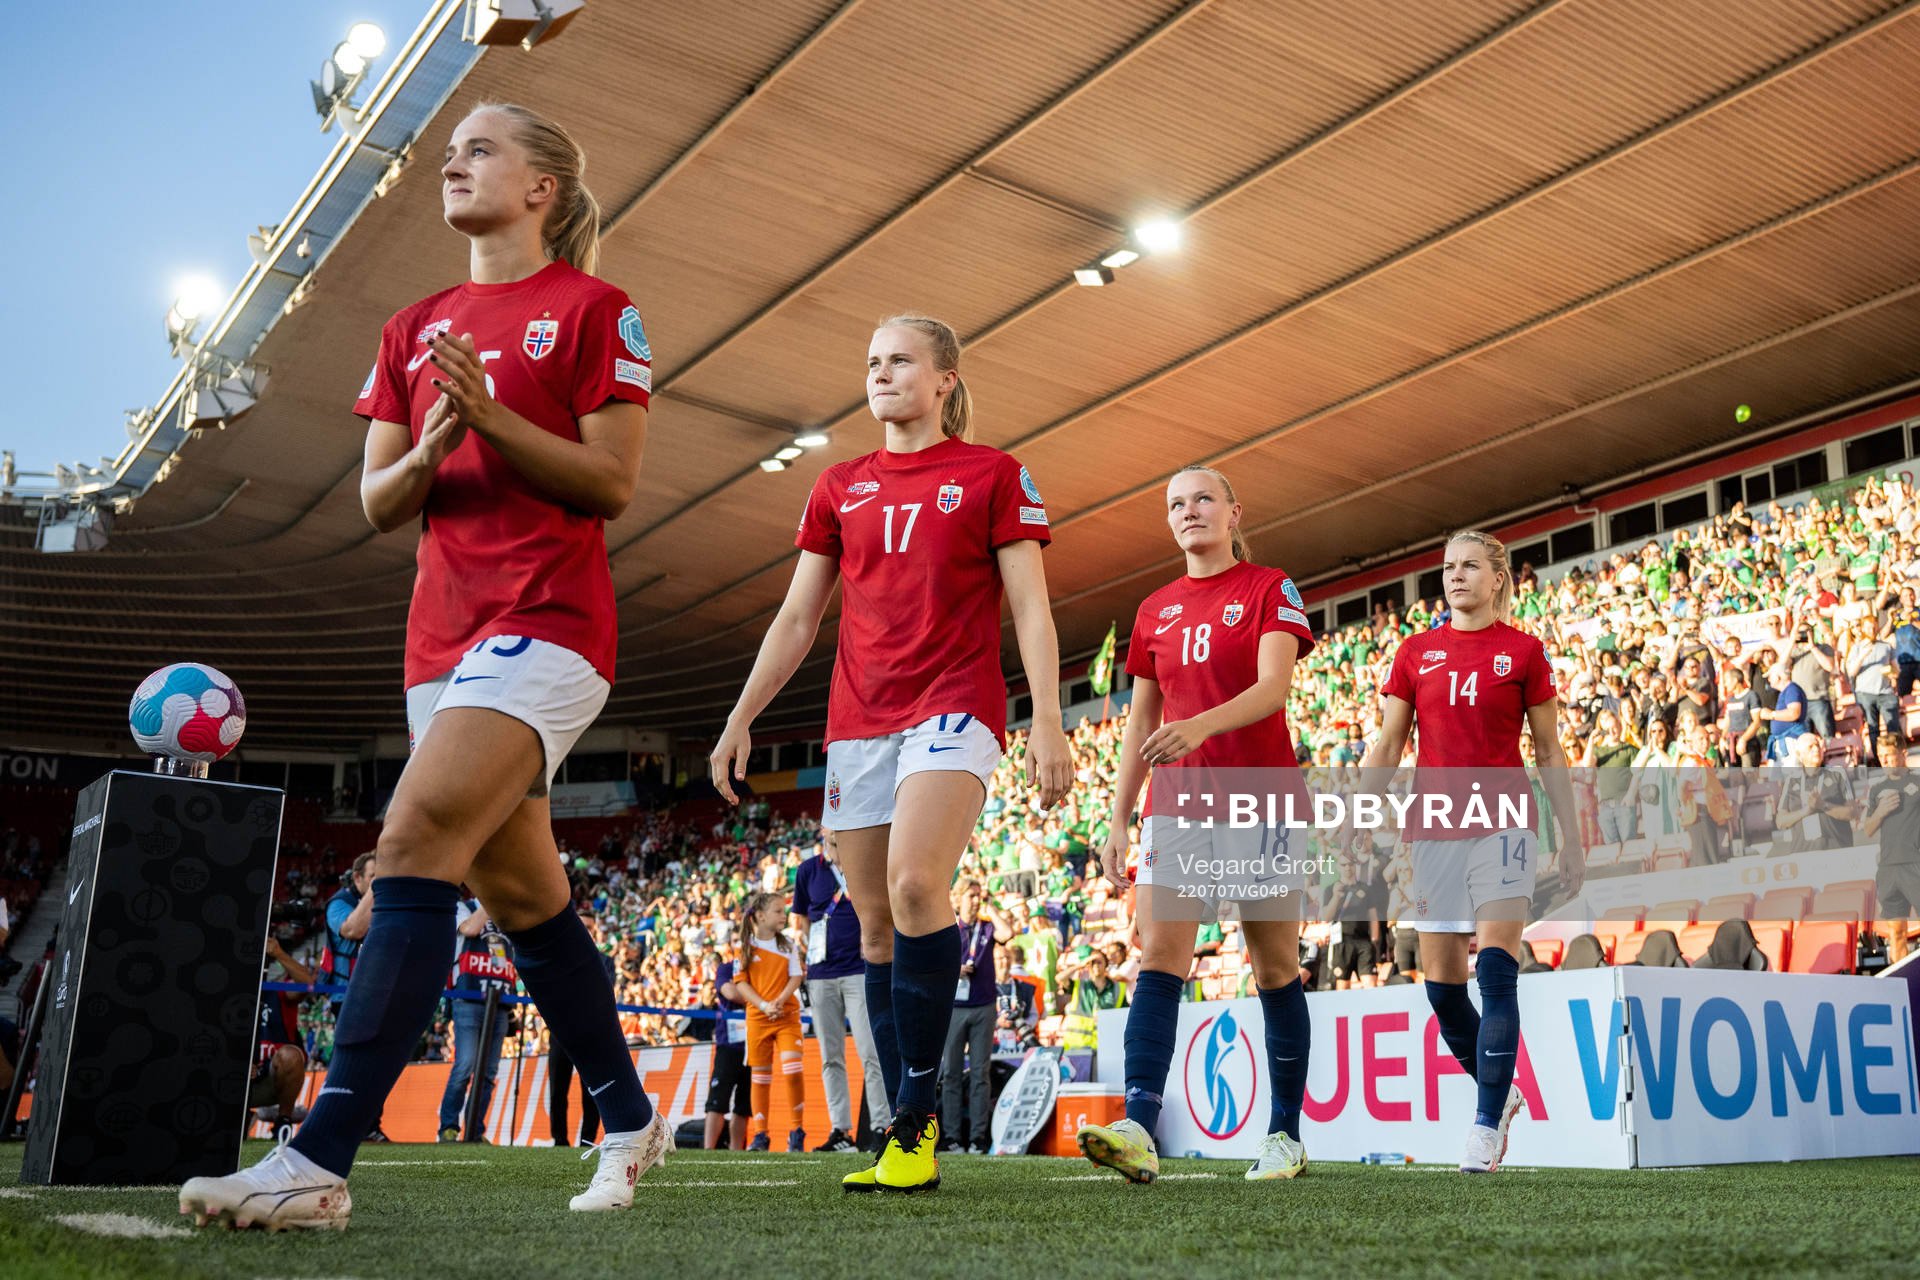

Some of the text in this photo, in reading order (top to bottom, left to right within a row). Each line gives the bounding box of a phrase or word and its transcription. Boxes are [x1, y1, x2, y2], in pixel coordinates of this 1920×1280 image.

[882, 503, 923, 553] 17
[1182, 623, 1212, 666] 18
[1449, 671, 1478, 706] 14
[1499, 835, 1527, 872] 14
[1568, 996, 1917, 1121] WOME
